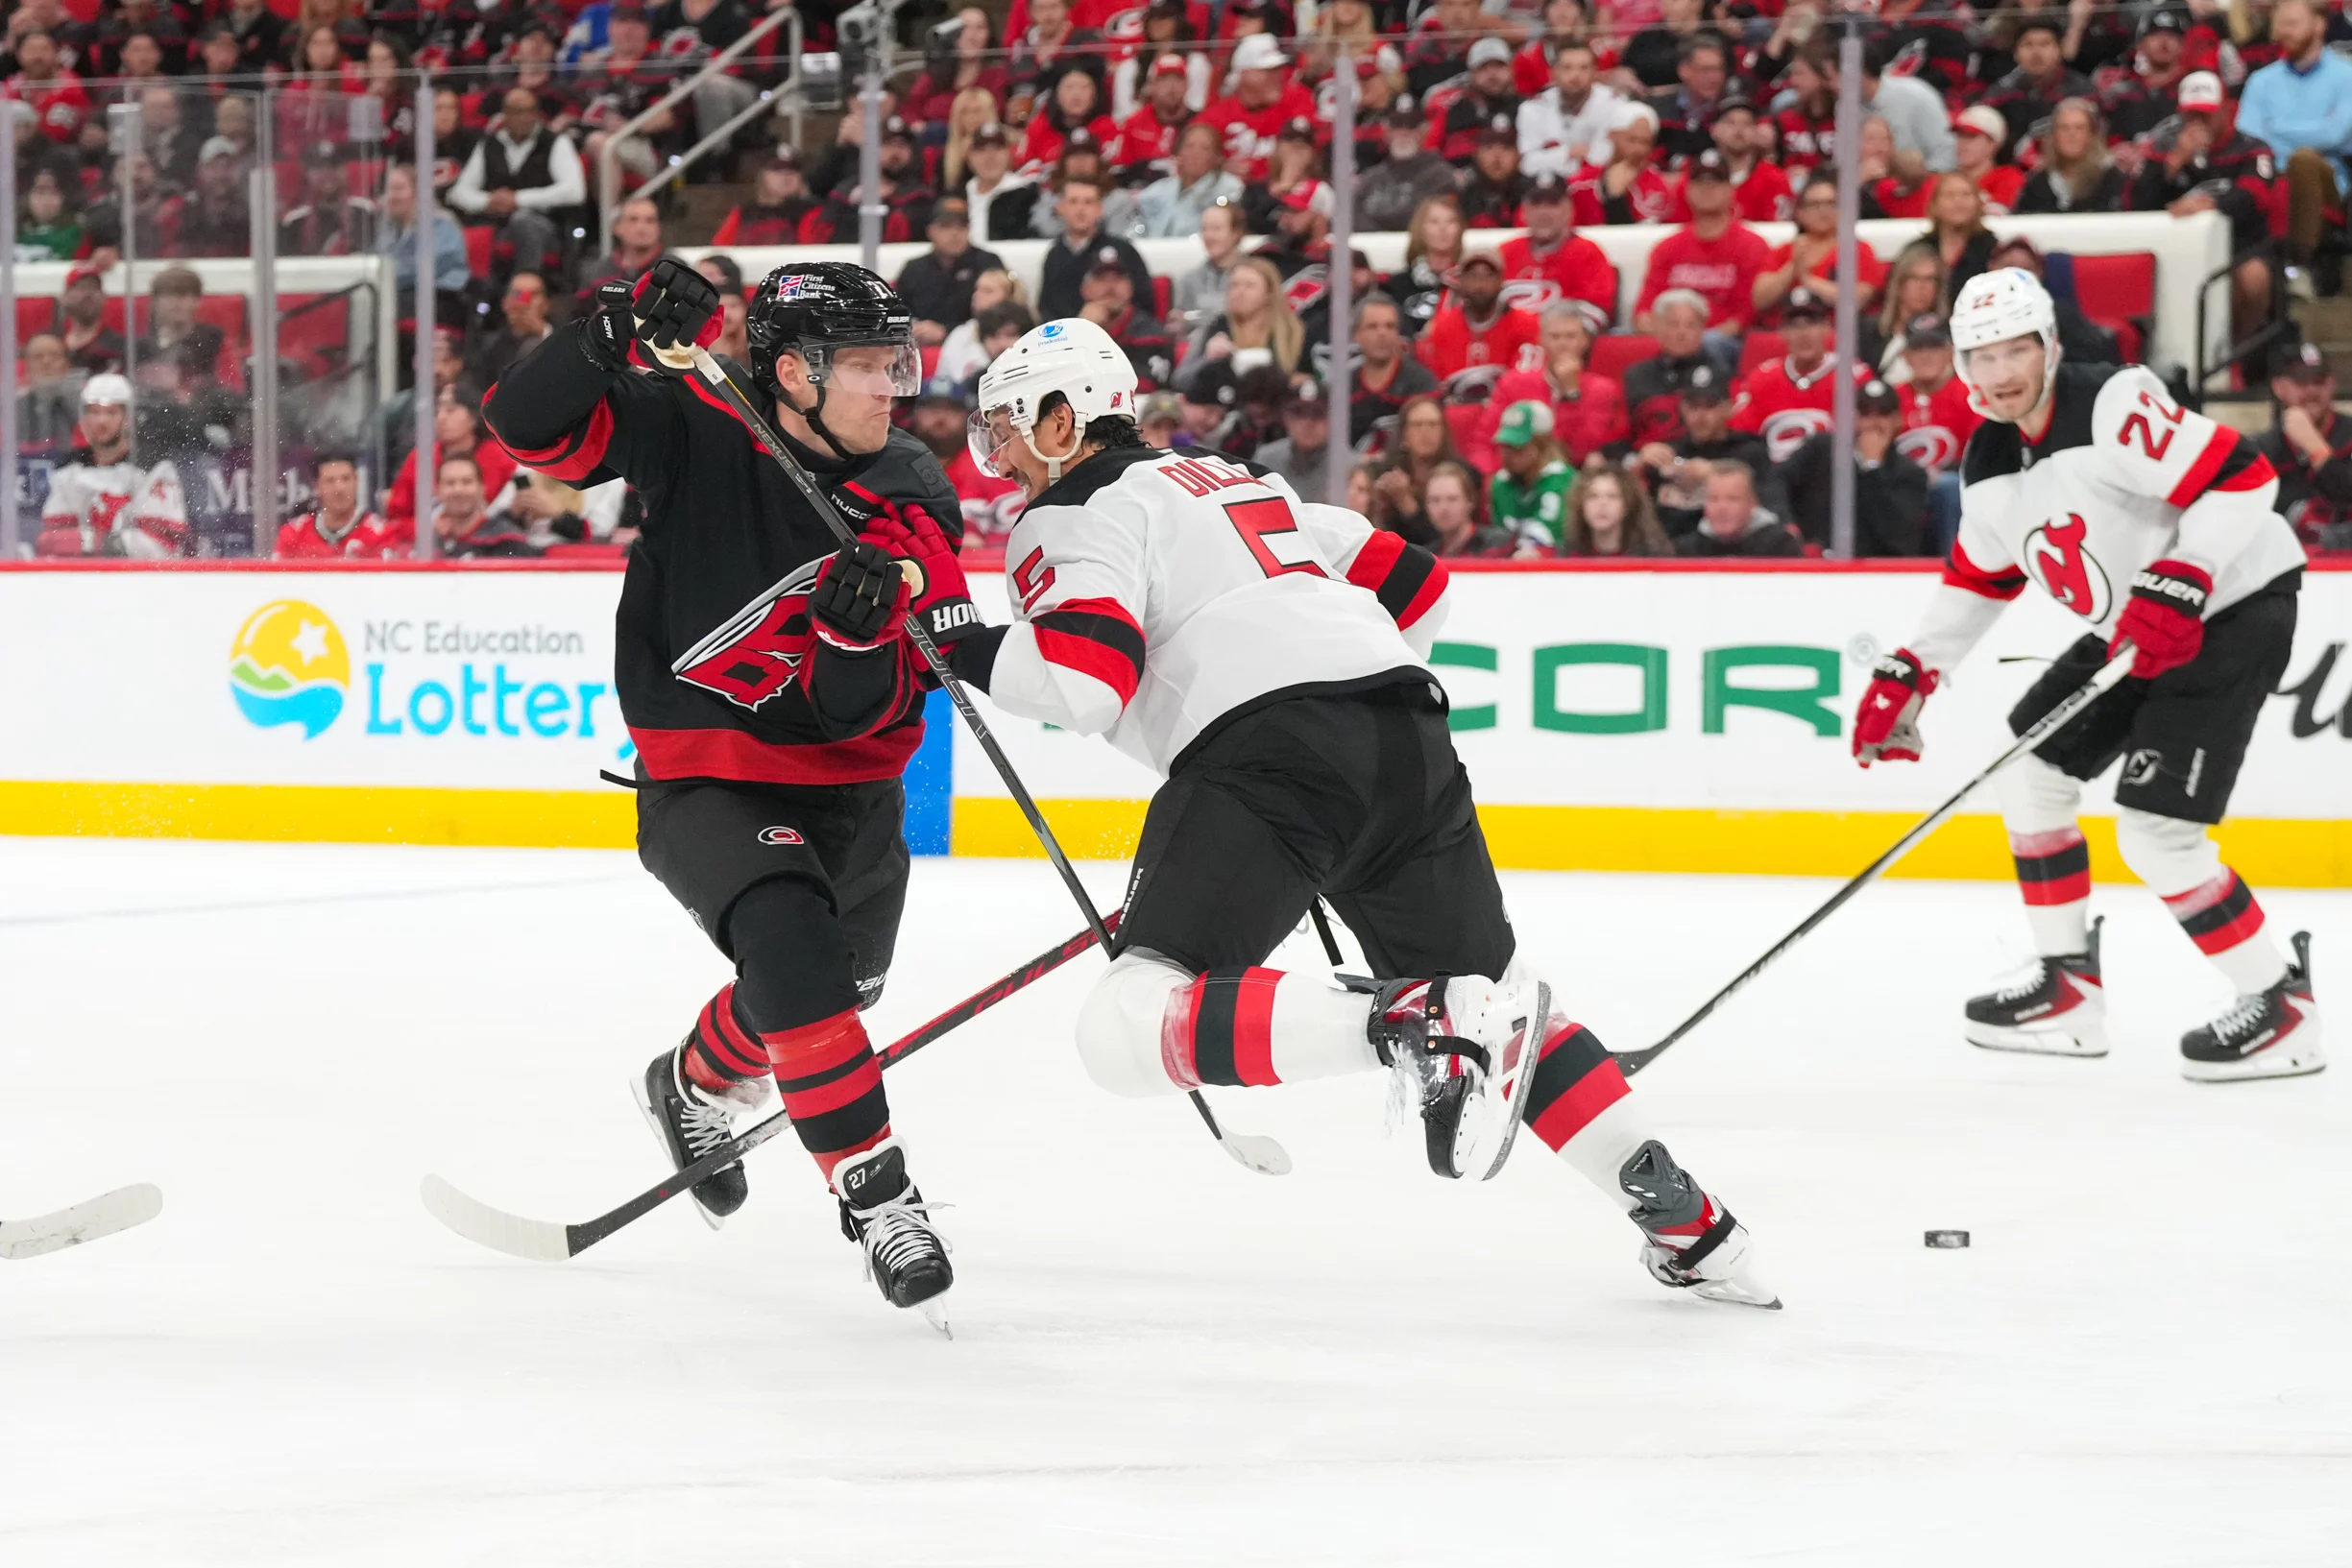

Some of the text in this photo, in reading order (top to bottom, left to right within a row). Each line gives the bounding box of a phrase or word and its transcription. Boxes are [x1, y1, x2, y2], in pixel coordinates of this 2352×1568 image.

[799, 290, 821, 299] Bank
[801, 281, 836, 292] Citizens
[804, 275, 824, 283] First
[602, 315, 615, 340] MACH
[1037, 336, 1068, 347] Prudential
[2118, 390, 2186, 462] 22
[752, 422, 794, 470] NEXUS
[1157, 459, 1264, 497] DILL
[831, 493, 871, 520] NUCO
[1222, 495, 1330, 579] 5
[1012, 544, 1055, 615] 5
[2133, 571, 2206, 607] AUER
[364, 621, 584, 655] NC Education
[1428, 641, 1842, 736] COR
[1118, 867, 1144, 925] BAUER
[848, 1168, 866, 1190] 27
